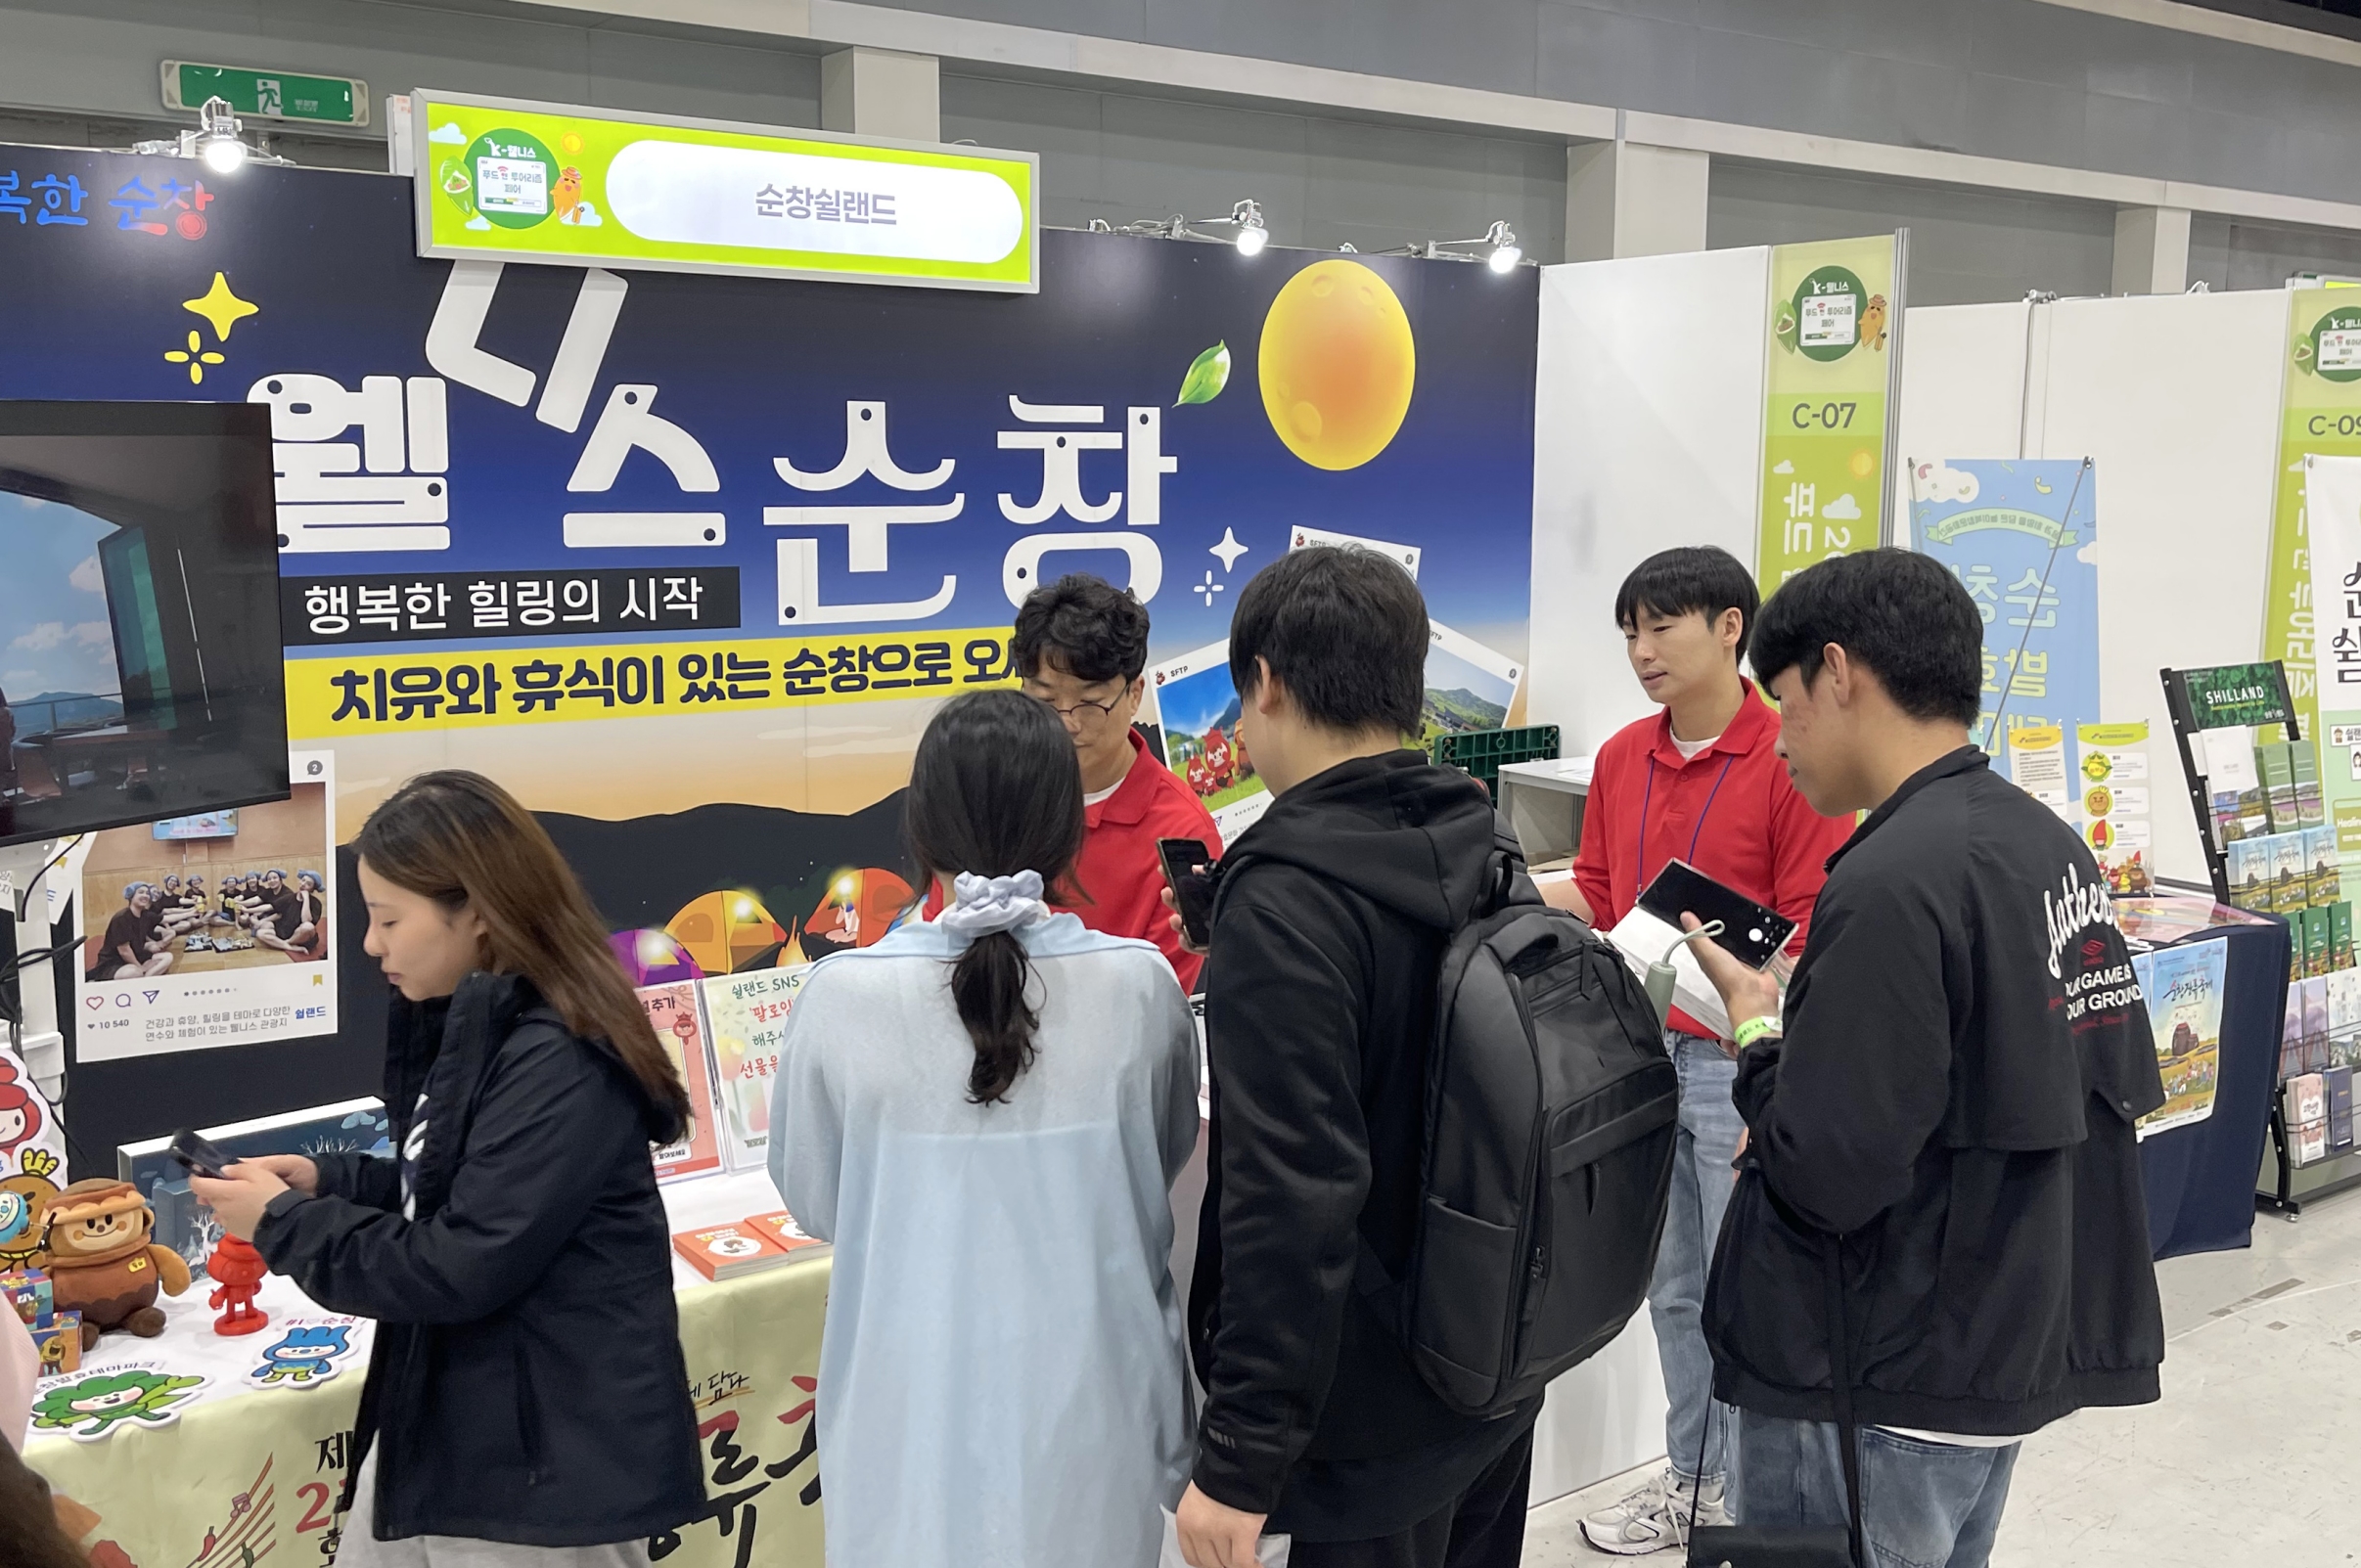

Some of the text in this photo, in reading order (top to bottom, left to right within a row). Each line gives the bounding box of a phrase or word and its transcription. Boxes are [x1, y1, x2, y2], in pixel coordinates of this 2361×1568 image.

[109, 176, 214, 240] 순창
[755, 183, 897, 226] 순창쉴랜드
[1792, 402, 1857, 428] C-07
[763, 395, 1177, 626] 순창
[1824, 526, 1851, 560] 2
[305, 576, 704, 635] 행복한 힐링의 시작
[331, 662, 502, 722] 치유와
[513, 655, 663, 713] 휴식이
[678, 651, 772, 703] 있는
[783, 642, 953, 696] 순창으로
[1170, 665, 1188, 678] SFTP
[2205, 686, 2265, 705] SHILLAND
[2337, 816, 2361, 829] Healin
[731, 974, 800, 1000] 쉴랜드 SNS
[2081, 965, 2125, 989] GAME
[2088, 984, 2142, 1010] GROUND
[99, 1018, 129, 1030] 10 540
[146, 1017, 174, 1030] 건강과
[233, 1008, 261, 1020] 테마로
[263, 1006, 291, 1017] 다양한
[295, 1006, 326, 1020] 쉴랜드
[209, 1024, 228, 1035] 있는
[260, 1018, 288, 1030] 관광지
